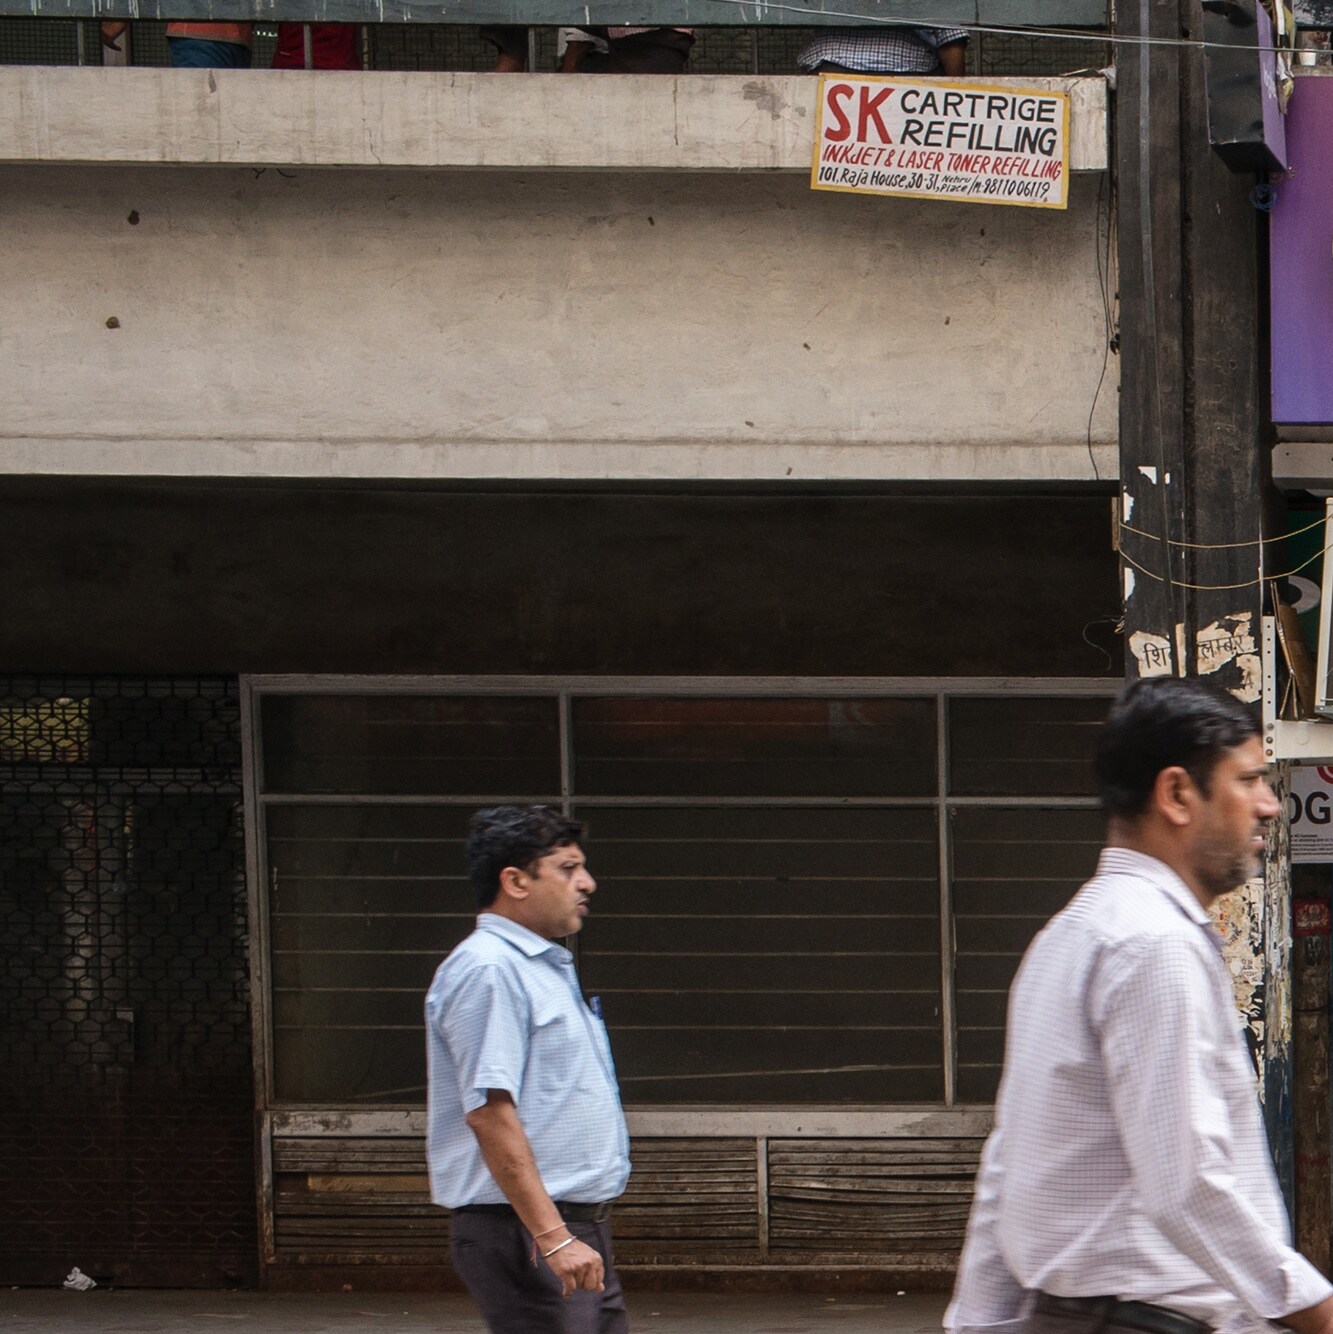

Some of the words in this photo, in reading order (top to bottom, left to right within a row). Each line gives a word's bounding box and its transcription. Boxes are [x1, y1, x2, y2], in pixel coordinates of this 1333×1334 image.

[825, 84, 895, 144] SK
[900, 89, 1057, 123] CARTRIGE
[901, 119, 1057, 157] REFILLING
[822, 143, 884, 168] INKJET
[884, 149, 893, 168] &
[897, 150, 944, 171] LASER
[947, 153, 992, 175] TONER
[992, 158, 1062, 182] REFILLING
[941, 174, 971, 184] Nehru
[941, 183, 968, 193] Place
